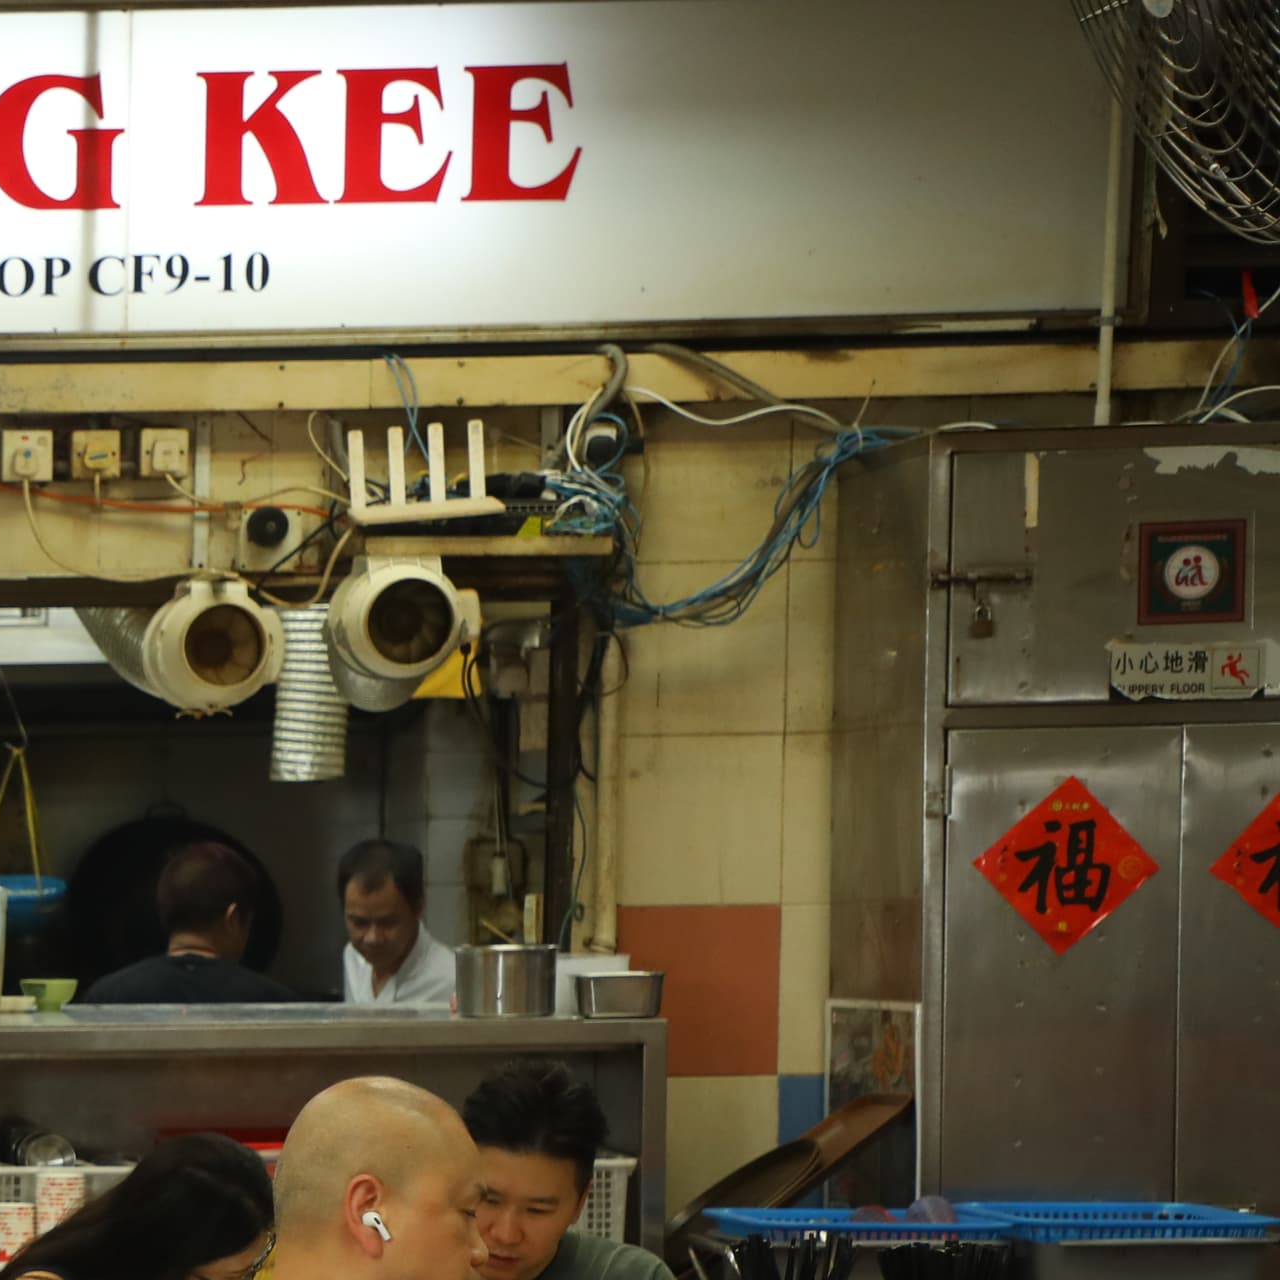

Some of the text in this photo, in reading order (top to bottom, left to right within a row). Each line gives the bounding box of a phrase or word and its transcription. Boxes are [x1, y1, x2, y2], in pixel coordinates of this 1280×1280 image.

[194, 62, 582, 207] KEE
[87, 253, 270, 296] CF9-10
[1115, 650, 1209, 675] 小心地滑
[1170, 683, 1205, 694] FLOOR
[1013, 819, 1111, 914] 福
